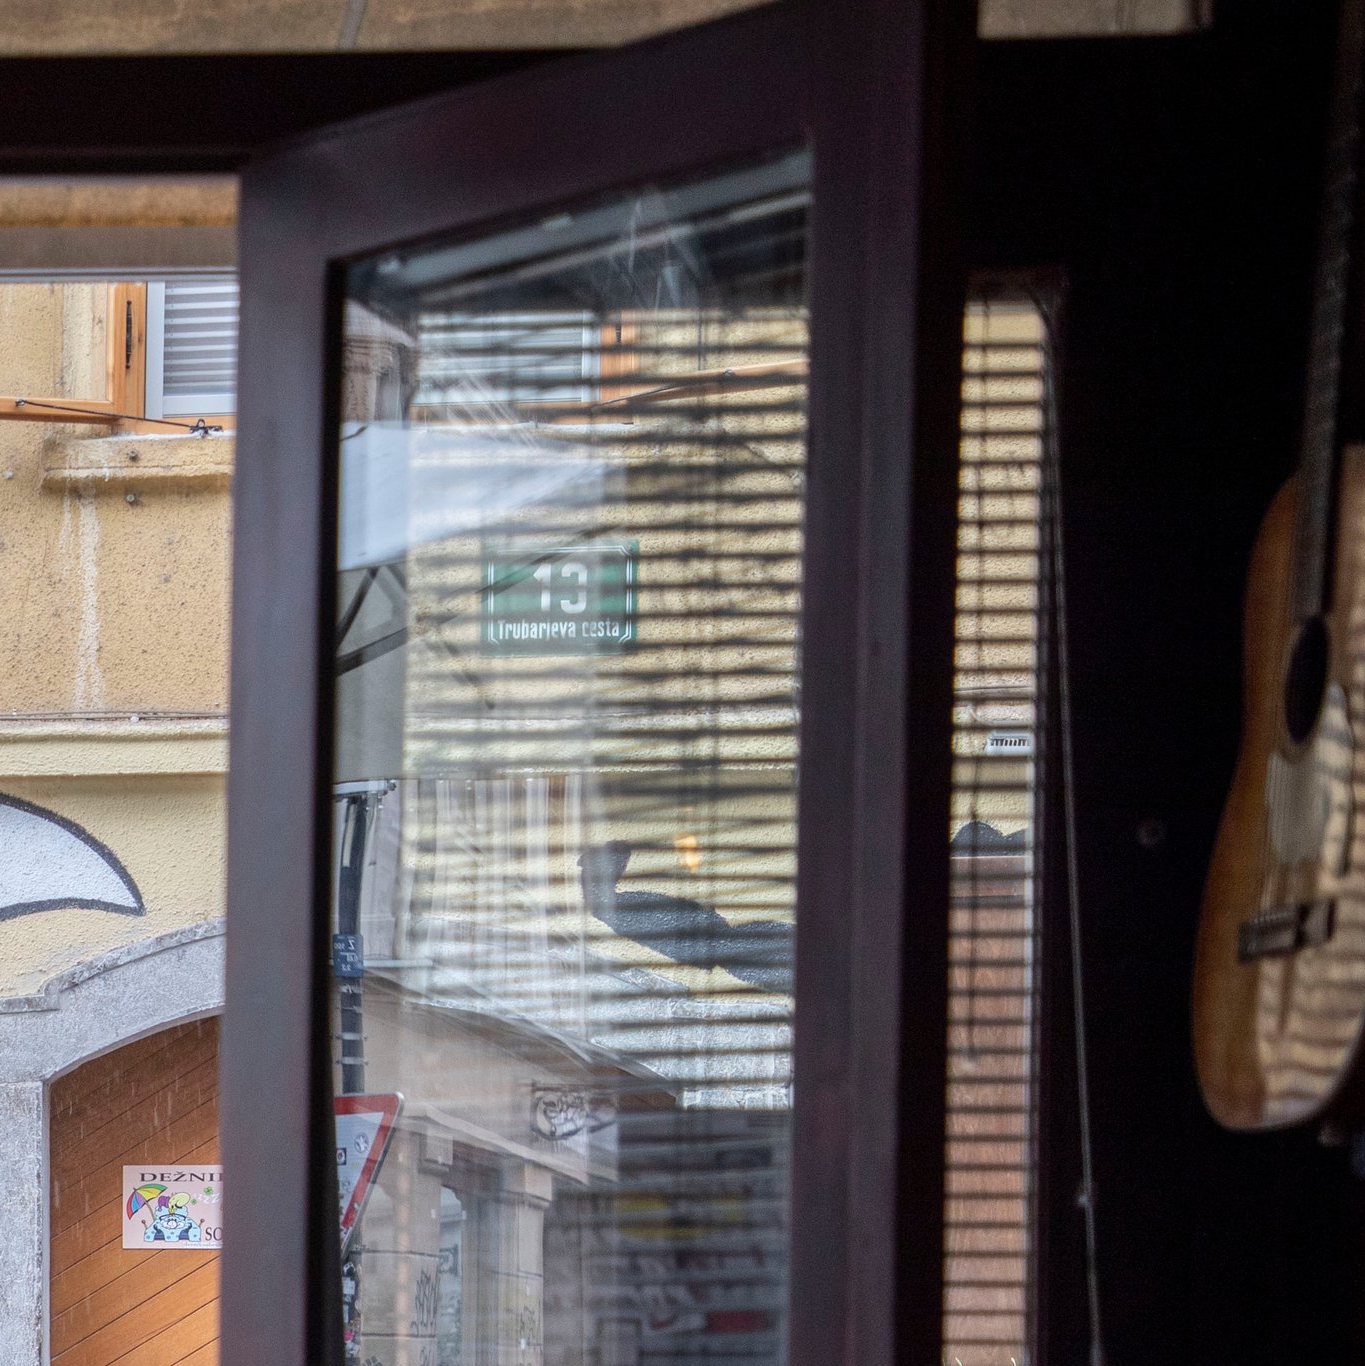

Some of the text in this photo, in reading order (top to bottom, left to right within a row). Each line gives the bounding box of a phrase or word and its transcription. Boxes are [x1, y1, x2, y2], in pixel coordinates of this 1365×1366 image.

[533, 562, 588, 613] 13
[497, 618, 619, 641] Trubarjeva cesta
